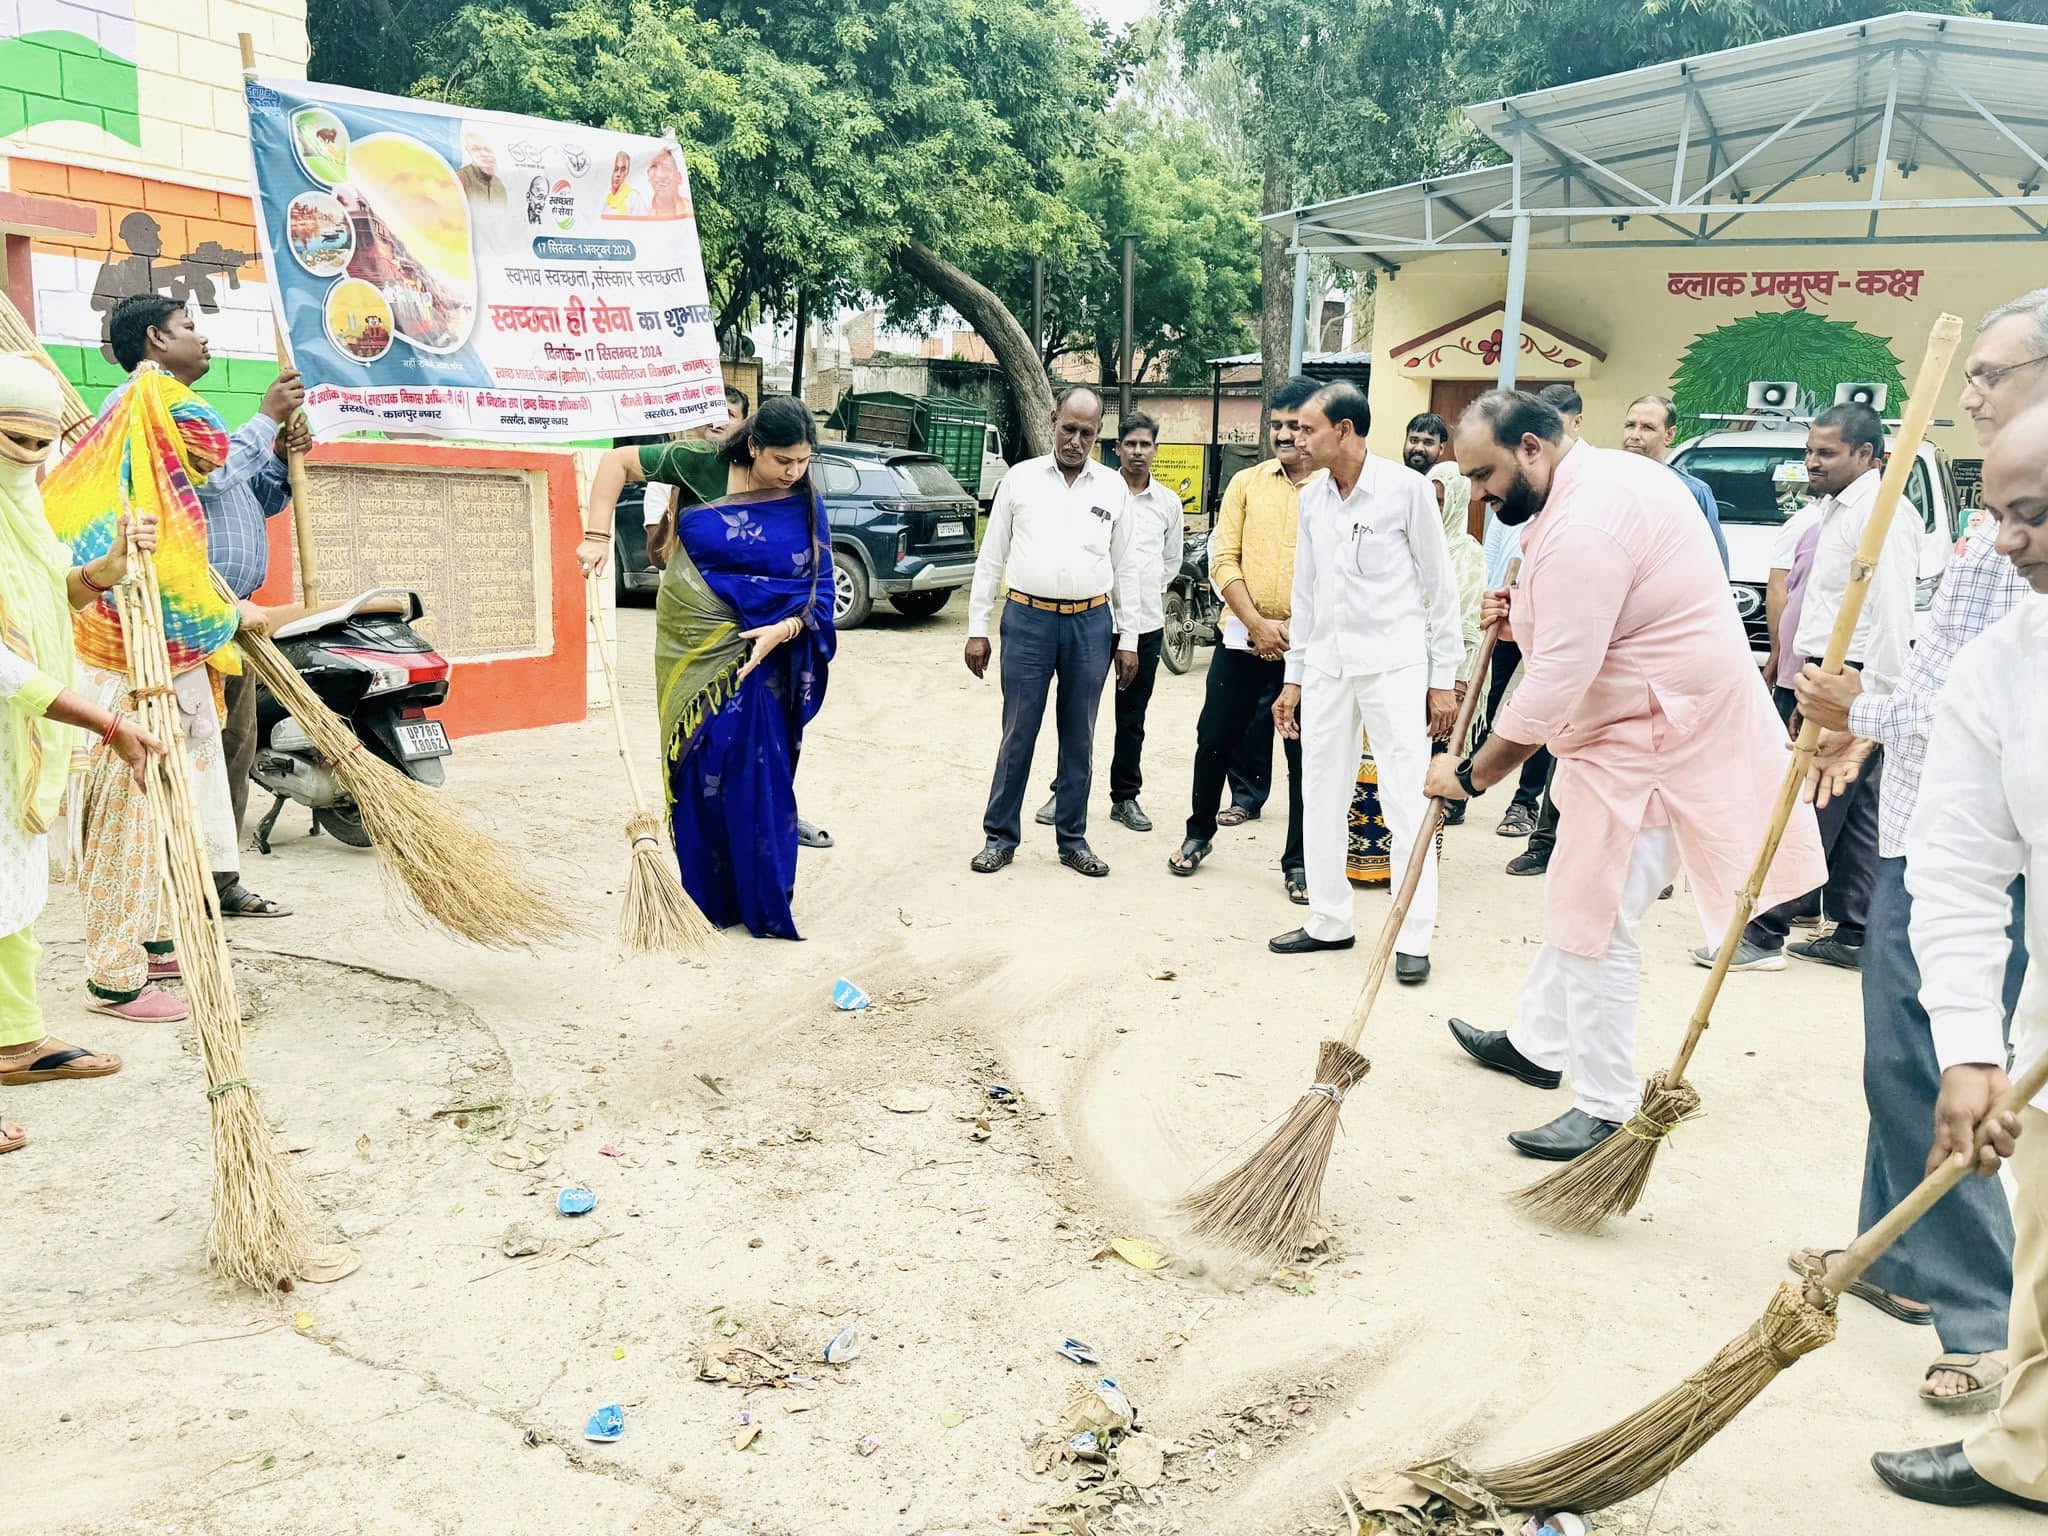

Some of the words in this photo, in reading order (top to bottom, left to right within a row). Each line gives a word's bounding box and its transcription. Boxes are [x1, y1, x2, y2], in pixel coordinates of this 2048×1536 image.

[537, 242, 547, 253] 17
[612, 245, 631, 256] 2024
[504, 267, 542, 287] स्वभाव
[637, 266, 687, 287] स्वच्छता
[1668, 271, 1747, 300] ब्लाक
[1855, 268, 1925, 302] कक्ष
[487, 303, 562, 333] स्वच्छता
[563, 294, 588, 336] ही
[590, 296, 634, 333] सेवा
[636, 310, 663, 331] का
[584, 351, 594, 361] 17
[597, 342, 639, 361] सितम्बर
[639, 345, 663, 358] 2024
[681, 358, 715, 375] कानपुर
[400, 388, 424, 405] विकास
[383, 409, 418, 422] कानपुर
[418, 410, 443, 419] नगर
[678, 401, 709, 414] कानपुर
[527, 415, 550, 429] कानपुर
[551, 416, 568, 426] नगर
